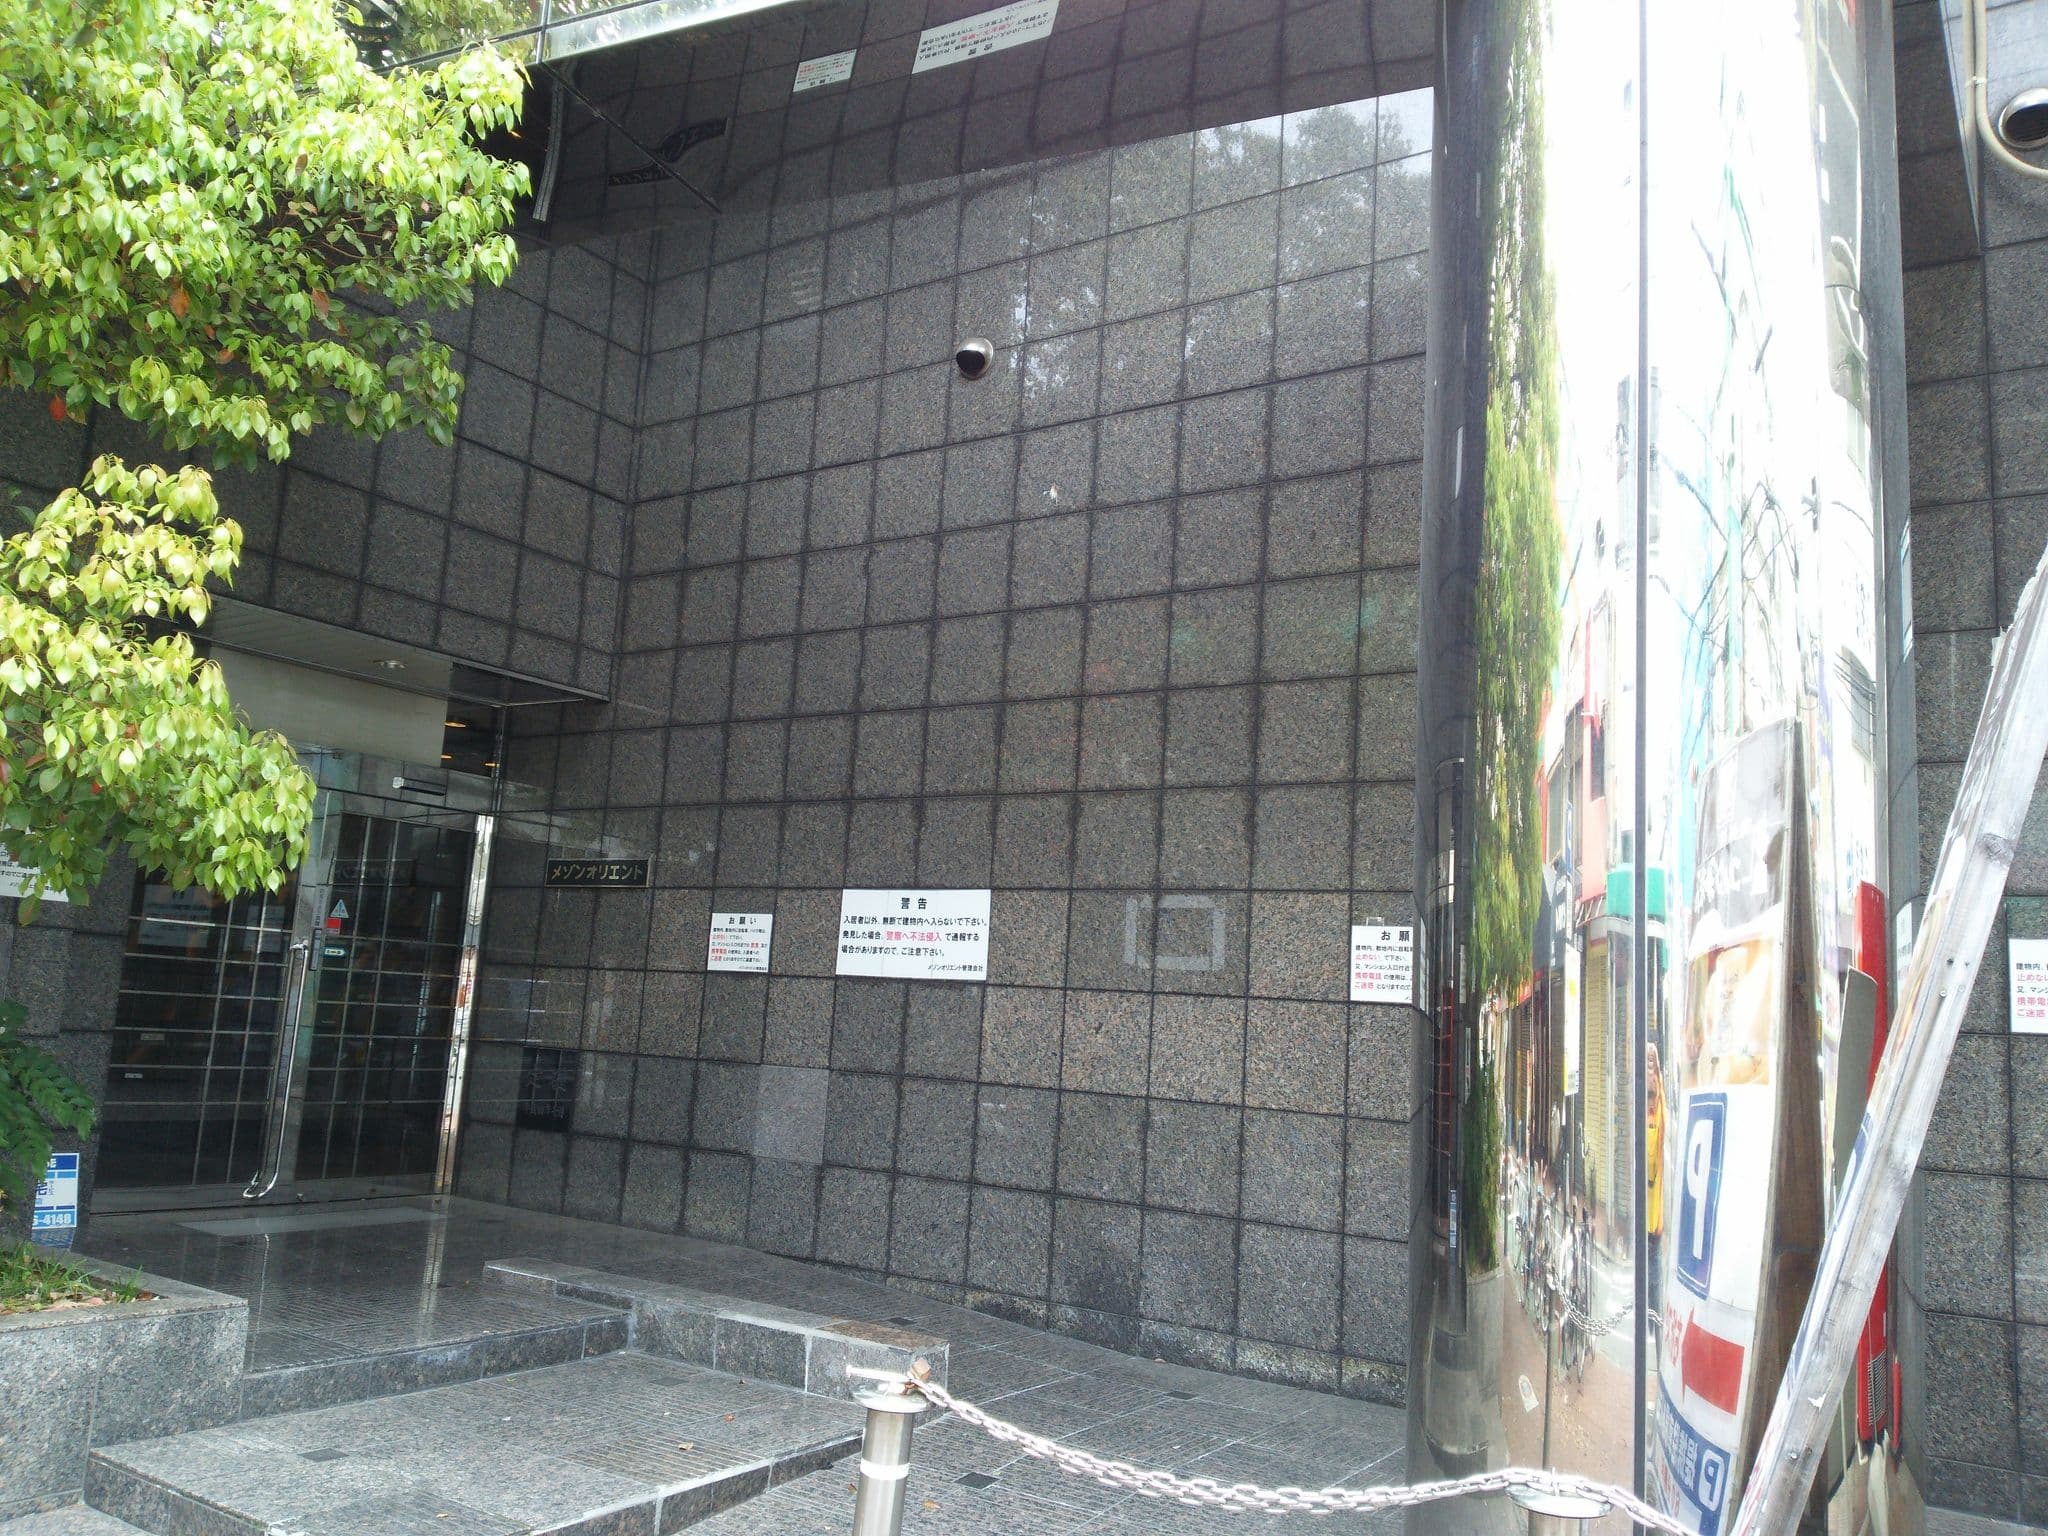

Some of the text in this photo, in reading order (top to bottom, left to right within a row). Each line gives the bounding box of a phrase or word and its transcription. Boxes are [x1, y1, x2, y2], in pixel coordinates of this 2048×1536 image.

[551, 864, 643, 880] メゾンオリエント
[901, 897, 928, 910] 警告
